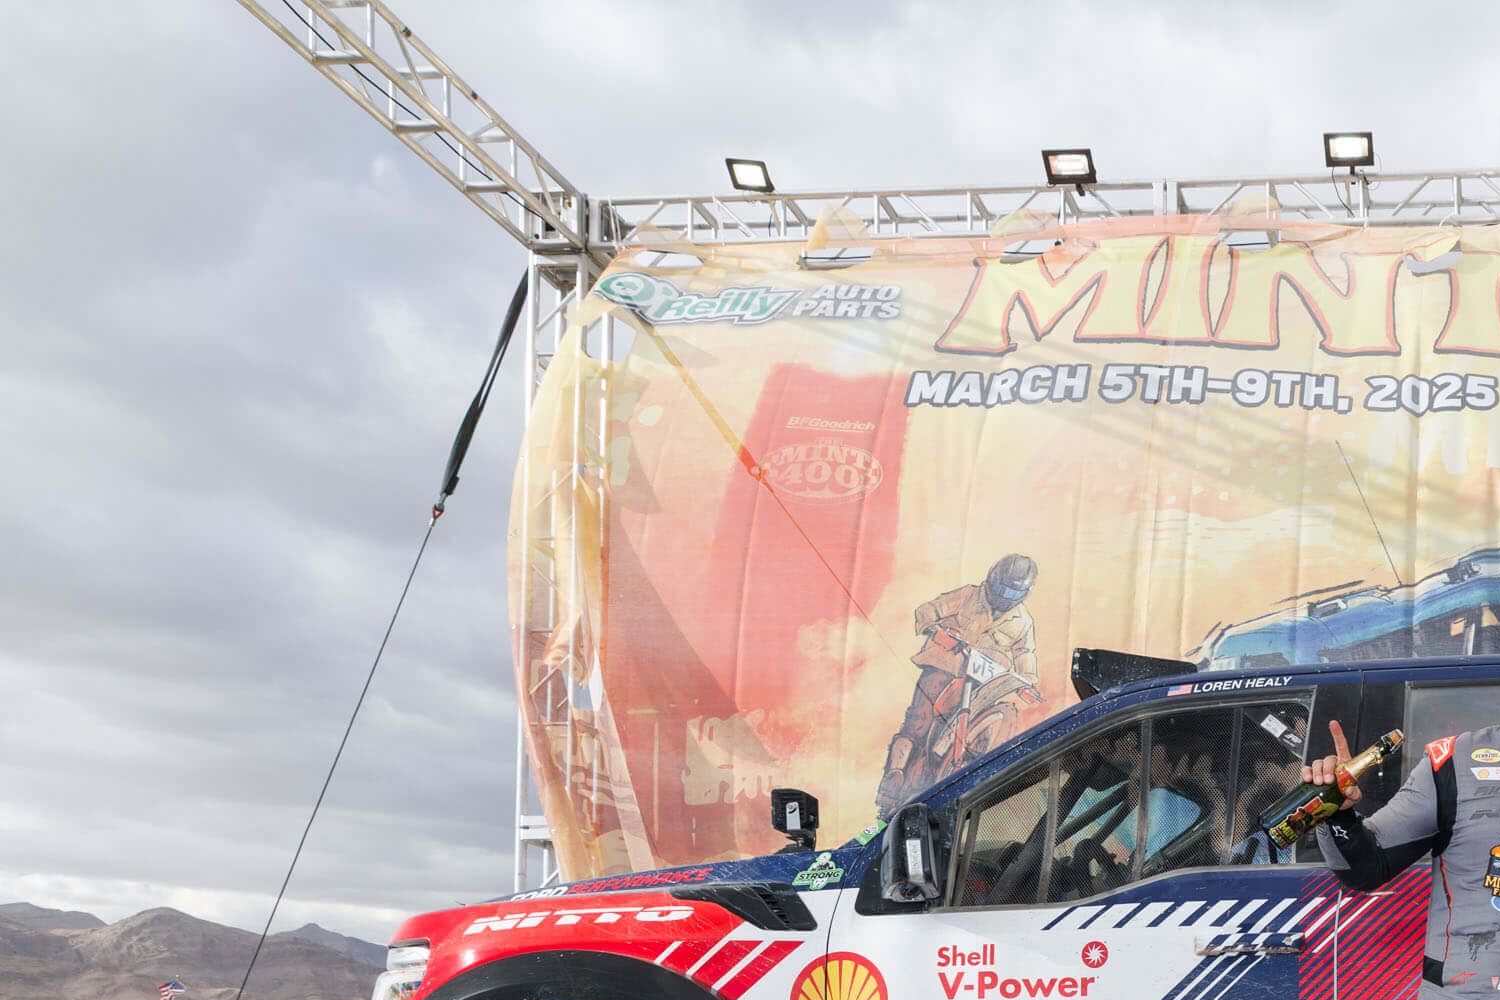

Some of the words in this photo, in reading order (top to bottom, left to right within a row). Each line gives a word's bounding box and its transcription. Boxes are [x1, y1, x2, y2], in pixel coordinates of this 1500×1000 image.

[812, 283, 901, 301] AUTO
[792, 299, 901, 319] PARTS
[906, 363, 1091, 408] MARCH
[1364, 373, 1500, 418] 2025
[785, 416, 878, 432] BFGoodrich
[1193, 679, 1244, 694] LOREN
[1244, 675, 1293, 689] HEALY
[566, 867, 714, 896] PERFORMANCE
[799, 871, 841, 881] STRONG
[463, 905, 695, 935] NITTO
[937, 944, 996, 967] Shell
[938, 970, 1096, 1000] V-Power
